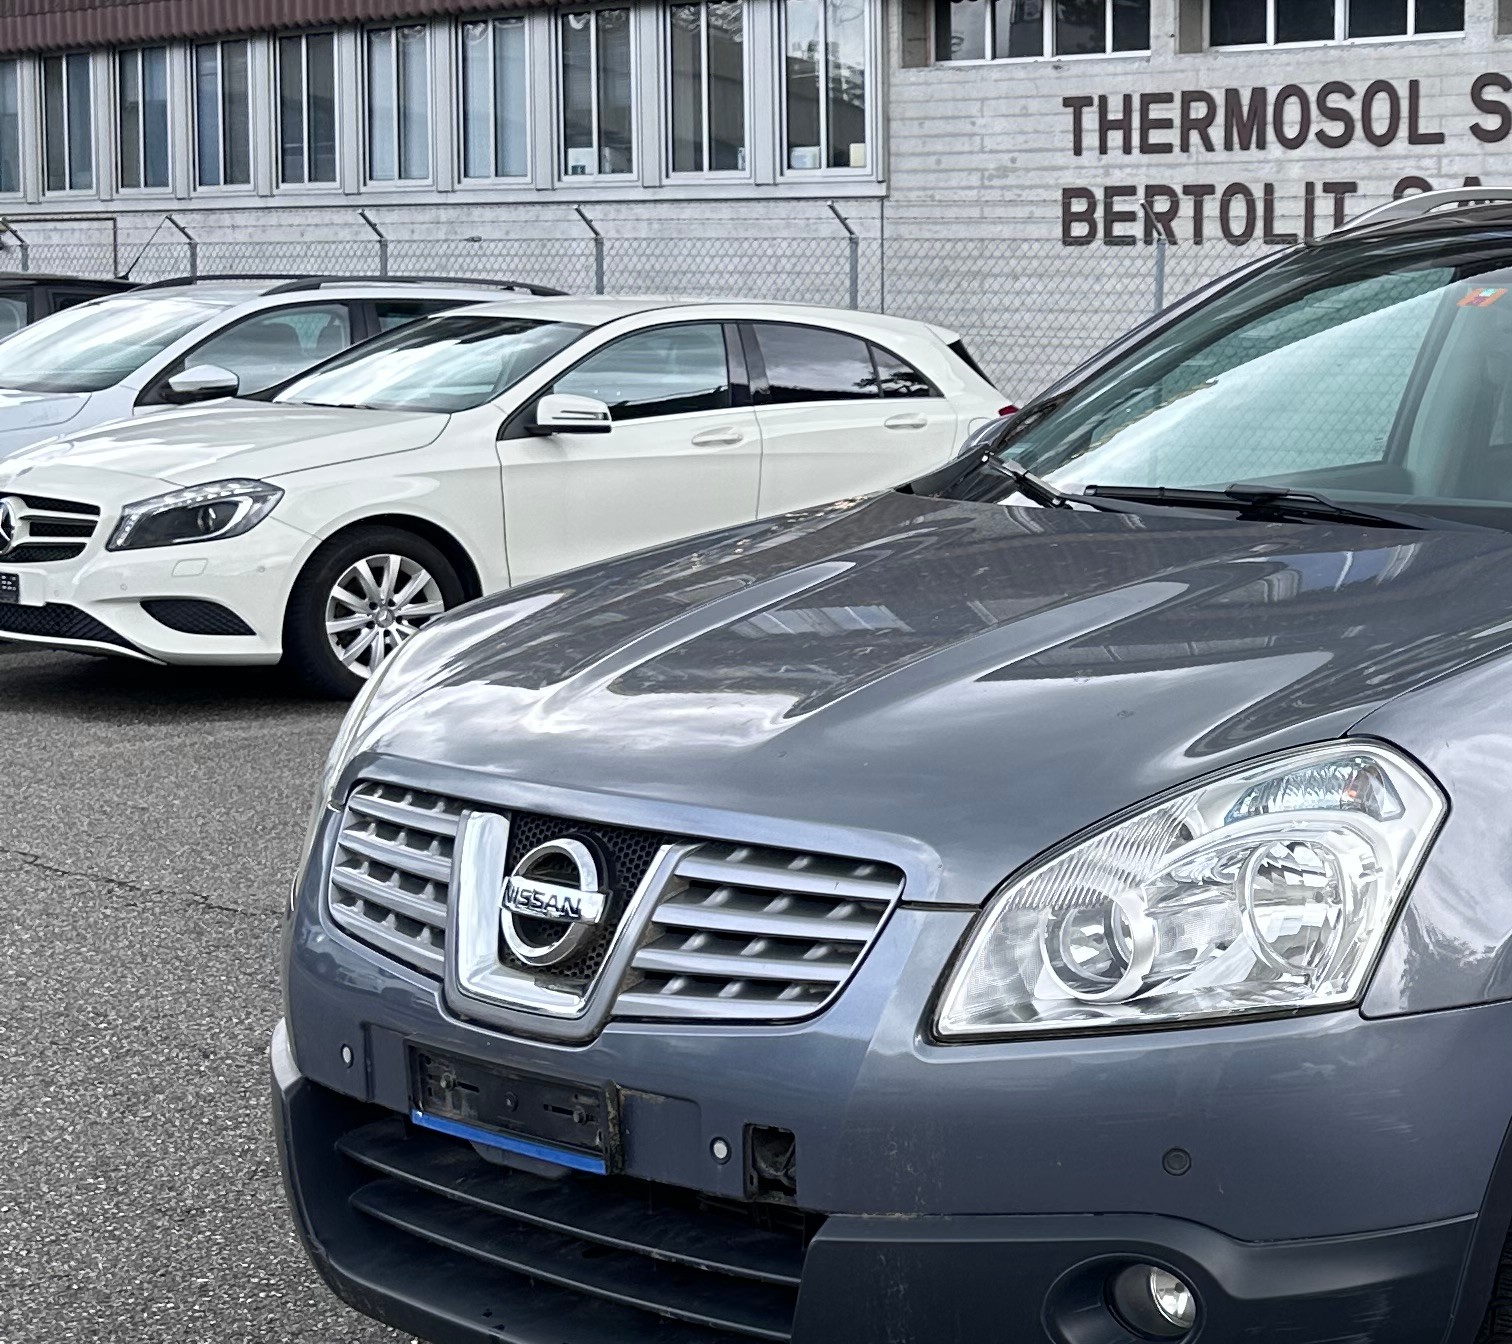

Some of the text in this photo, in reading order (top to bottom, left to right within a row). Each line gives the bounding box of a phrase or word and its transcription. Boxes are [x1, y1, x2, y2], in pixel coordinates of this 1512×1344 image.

[1062, 79, 1445, 155] THERMOSOL
[1061, 181, 1358, 246] BERTOLIT
[503, 881, 581, 918] NISSAN
